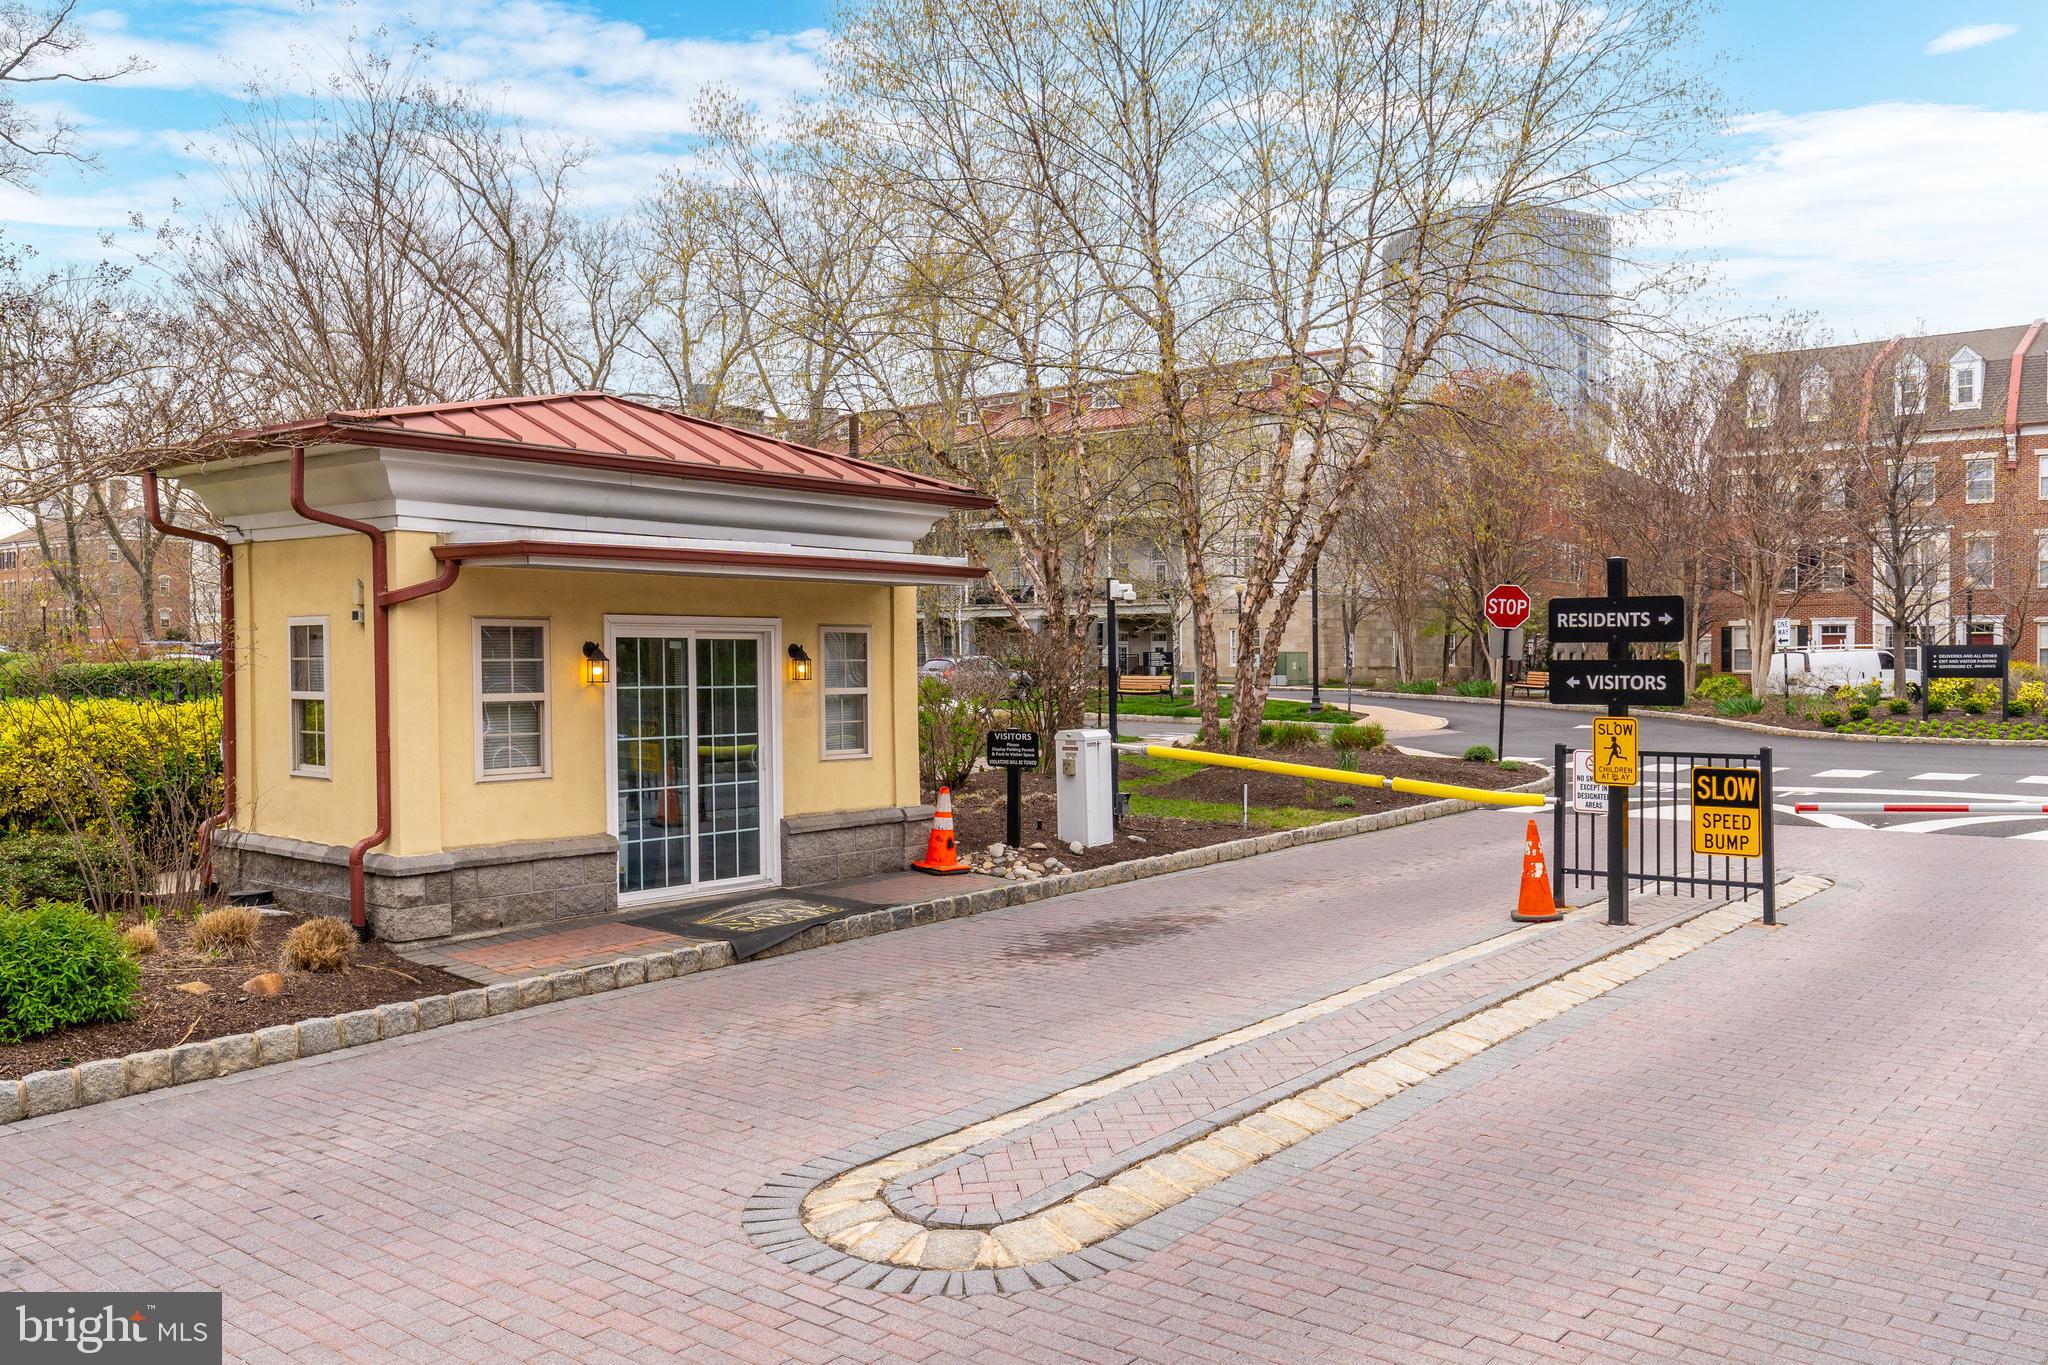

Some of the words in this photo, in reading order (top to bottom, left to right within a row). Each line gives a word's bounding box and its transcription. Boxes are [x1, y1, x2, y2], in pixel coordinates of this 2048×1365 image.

[1487, 598, 1527, 615] STOP
[1557, 612, 1651, 628] RESIDENTS
[1776, 620, 1789, 628] ONE
[1586, 675, 1667, 690] VISITORS
[1598, 723, 1633, 736] SLOW
[994, 732, 1032, 741] VISITORS
[1598, 766, 1633, 774] CHILDREN
[1576, 774, 1584, 782] NO
[1612, 773, 1630, 781] PLAY
[1697, 775, 1756, 802] SLOW
[1585, 801, 1603, 809] AREAS
[1703, 813, 1751, 830] SPEED
[1704, 833, 1749, 850] BUMP
